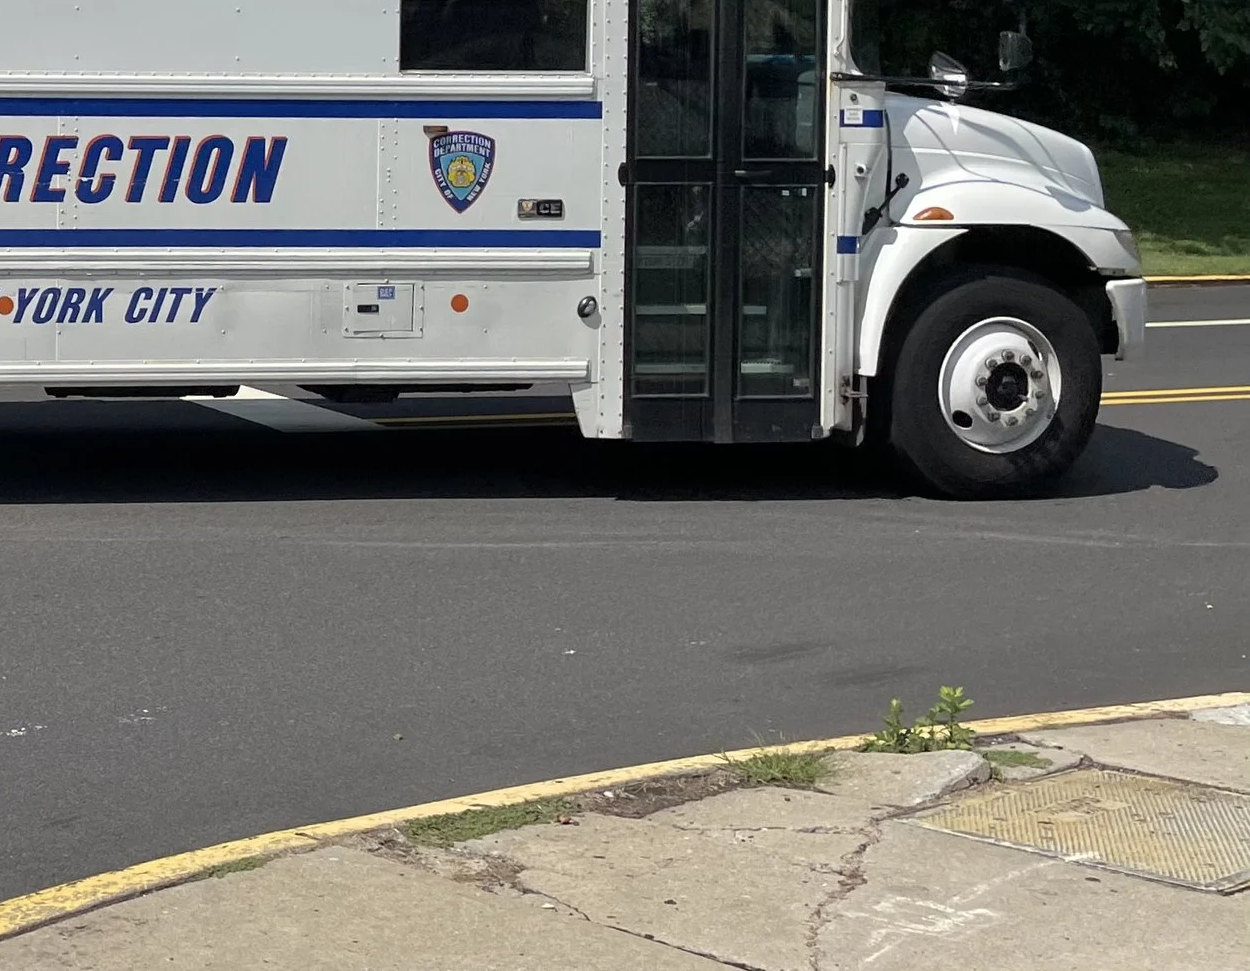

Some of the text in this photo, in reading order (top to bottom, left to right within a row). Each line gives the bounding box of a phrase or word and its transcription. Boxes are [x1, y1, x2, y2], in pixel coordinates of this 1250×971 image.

[433, 134, 491, 149] CORRECTION
[433, 142, 491, 158] DEPARTMENT
[434, 168, 453, 200] CITY OF
[467, 162, 491, 202] NEW YORK
[11, 288, 114, 324] YORK
[124, 287, 217, 324] CITY
